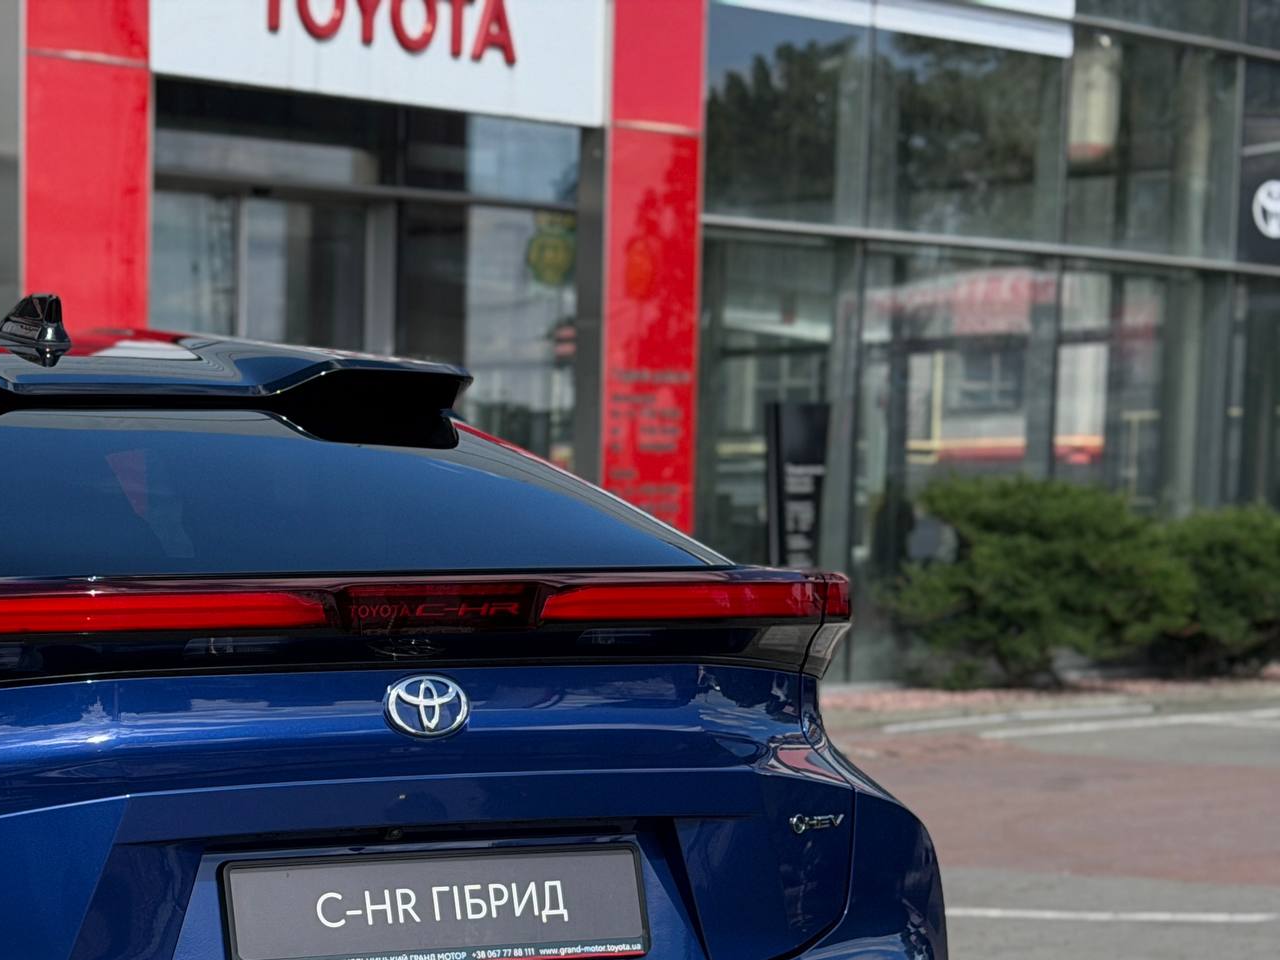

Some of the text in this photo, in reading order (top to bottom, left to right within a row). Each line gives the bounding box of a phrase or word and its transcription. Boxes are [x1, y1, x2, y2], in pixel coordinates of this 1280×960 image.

[350, 601, 520, 619] TOYOTA C-HR
[316, 880, 569, 928] C-HR ГІБРИД
[471, 949, 486, 959] +38
[486, 948, 501, 959] 067
[502, 948, 513, 957] 77
[524, 947, 536, 957] 111
[538, 943, 641, 955] www.grand-motor.toyota.ua
